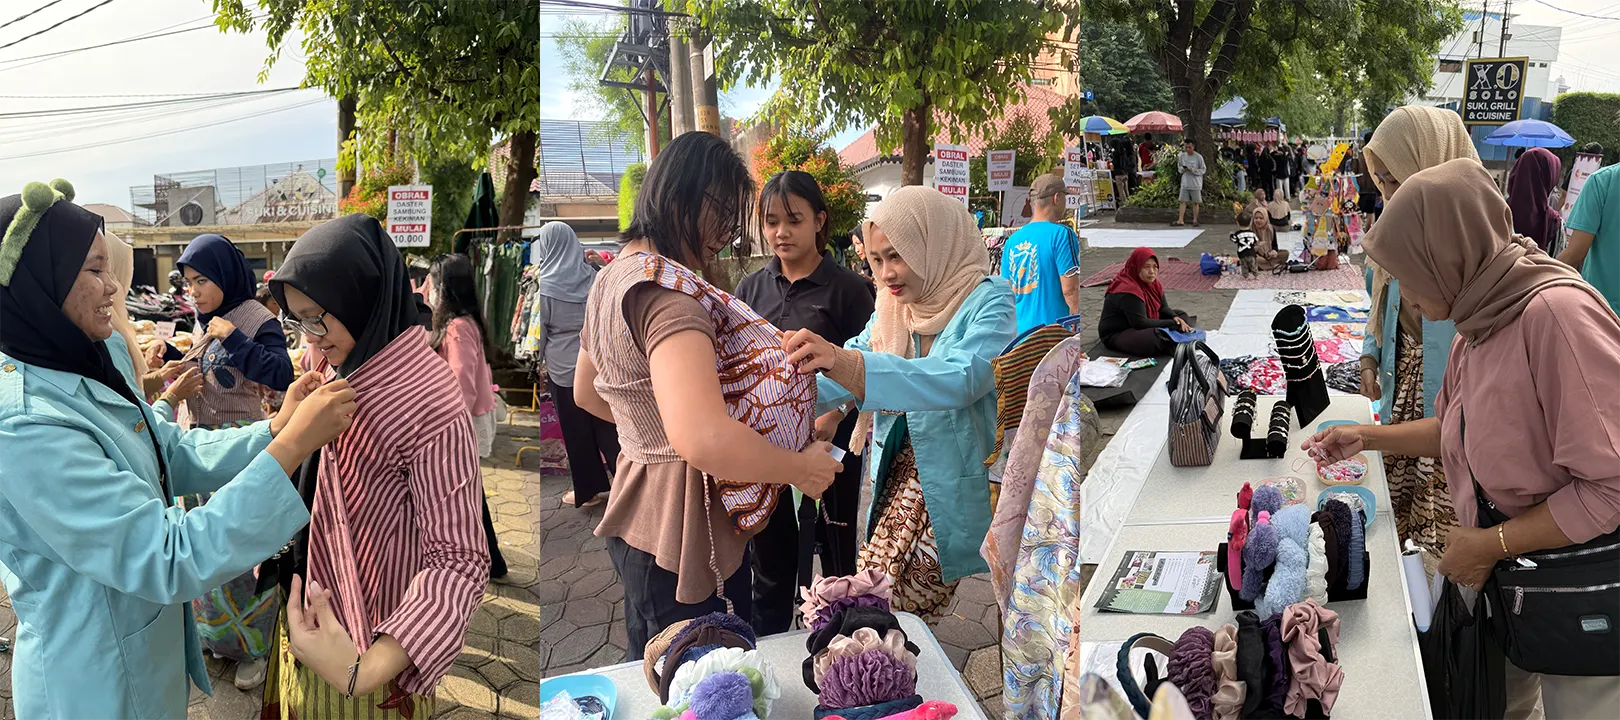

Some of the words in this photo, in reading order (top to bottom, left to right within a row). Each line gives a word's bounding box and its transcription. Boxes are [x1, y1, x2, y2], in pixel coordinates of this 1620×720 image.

[1469, 90, 1517, 100] SOLO
[1466, 102, 1489, 111] SUKI,
[1490, 102, 1516, 110] GRILL
[1476, 112, 1511, 120] CUISINE
[940, 150, 965, 160] OBRAL
[941, 161, 964, 169] DASTER
[941, 186, 964, 194] MULAI
[395, 191, 426, 199] OBRAL
[276, 205, 287, 217] &
[394, 234, 424, 243] 10.000
